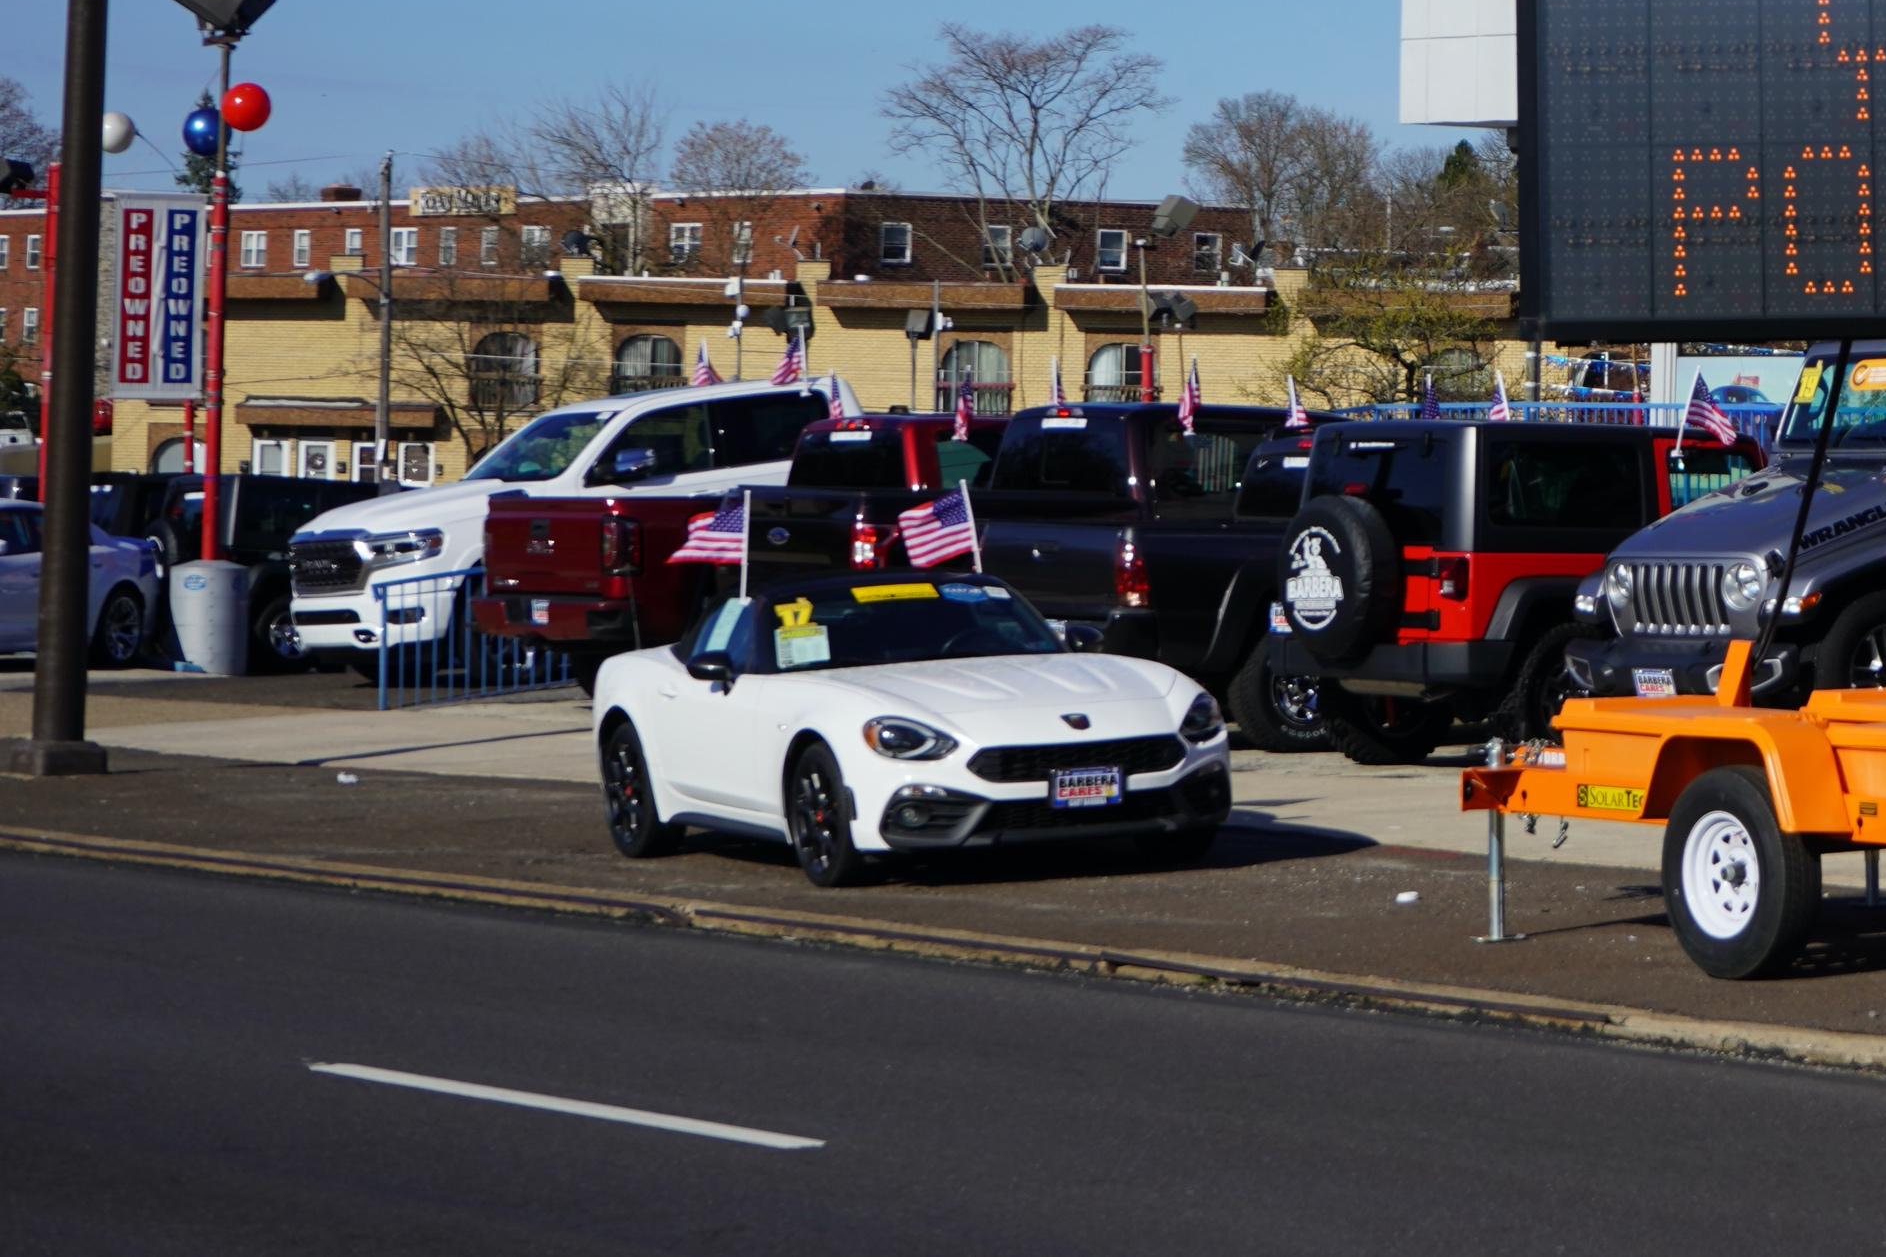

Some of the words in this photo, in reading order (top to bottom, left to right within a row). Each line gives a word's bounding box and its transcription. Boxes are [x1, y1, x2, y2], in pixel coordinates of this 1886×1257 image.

[123, 212, 150, 380] PREOWNED
[167, 212, 191, 380] PREOWNED
[1286, 577, 1344, 599] BARBERA
[774, 600, 814, 627] 17
[1638, 674, 1673, 686] BARBERA
[1639, 684, 1666, 692] CARES
[1059, 774, 1118, 788] BARBERA
[1059, 786, 1103, 798] CARES
